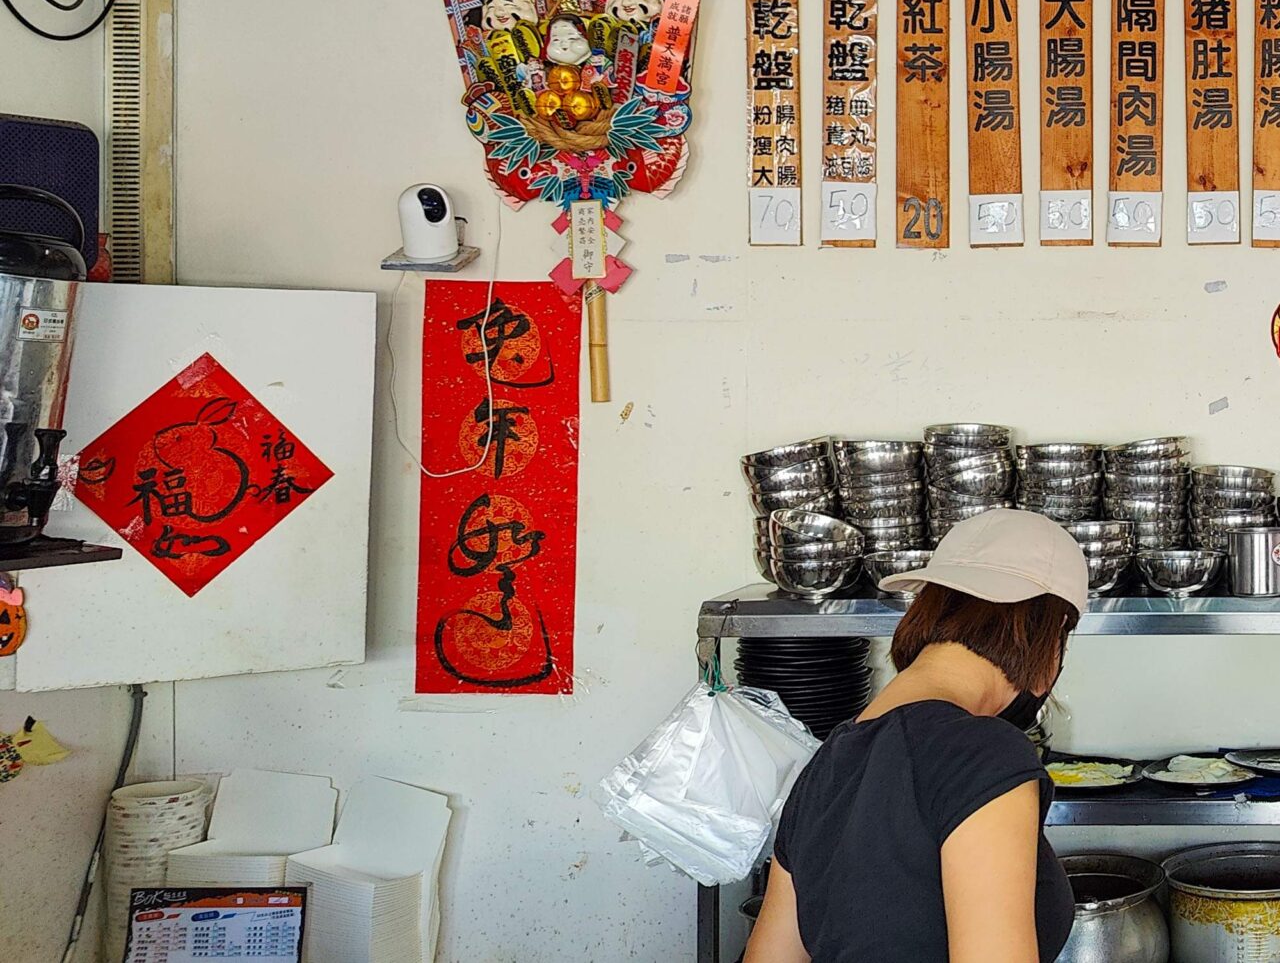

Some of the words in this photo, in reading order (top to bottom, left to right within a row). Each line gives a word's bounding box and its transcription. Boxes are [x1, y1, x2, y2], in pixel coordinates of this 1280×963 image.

[752, 165, 797, 186] 大腸
[757, 195, 794, 230] 70
[830, 190, 868, 230] 50
[903, 197, 943, 240] 20
